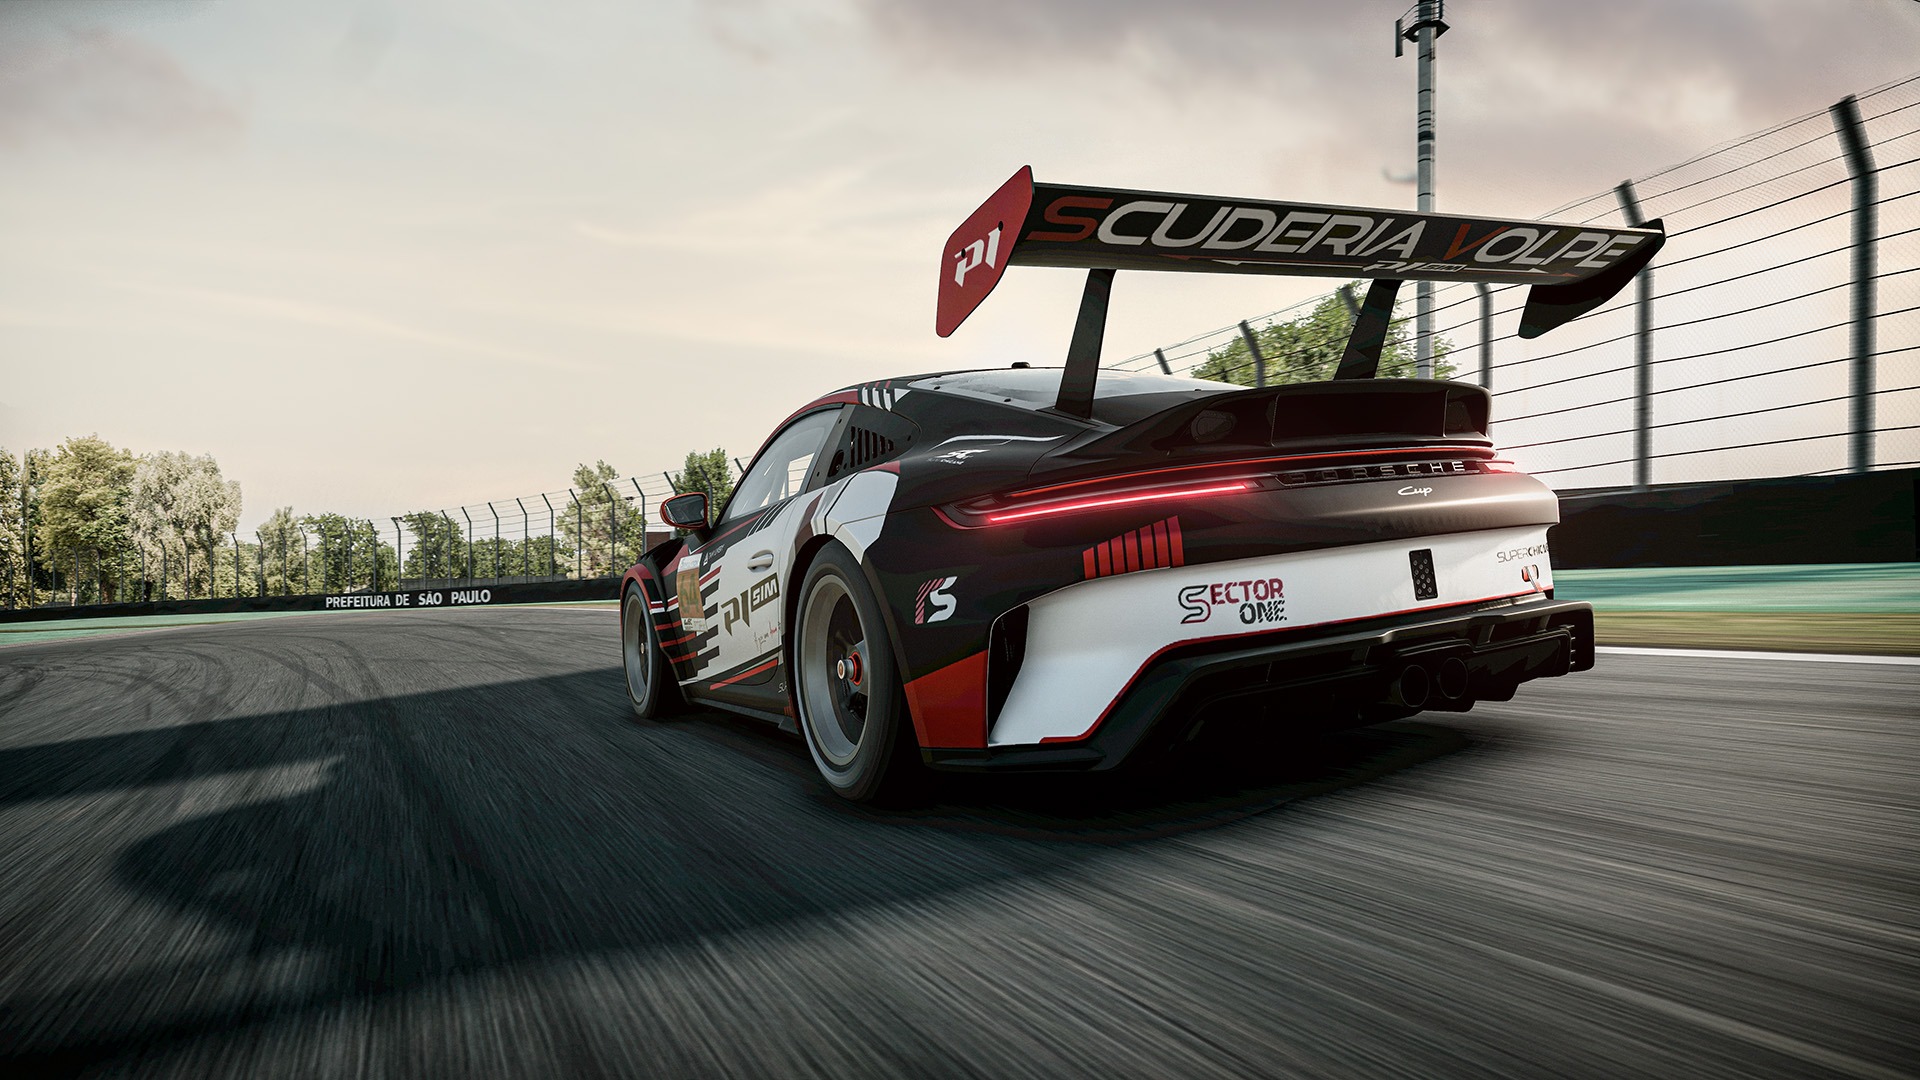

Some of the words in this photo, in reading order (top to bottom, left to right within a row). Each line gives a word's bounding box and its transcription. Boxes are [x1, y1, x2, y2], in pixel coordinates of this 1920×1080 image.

[1026, 195, 1427, 259] SCUDERIA
[1443, 223, 1647, 269] VOLPE
[1289, 461, 1466, 484] PORSCHE
[1397, 485, 1433, 497] Cup
[325, 594, 391, 608] PREFEITURA
[395, 593, 410, 606] DE
[418, 591, 443, 605] SÃO
[450, 589, 492, 604] PAULO
[752, 578, 778, 607] SIM
[1178, 577, 1285, 625] SECTOR
[1239, 599, 1288, 624] ONE
